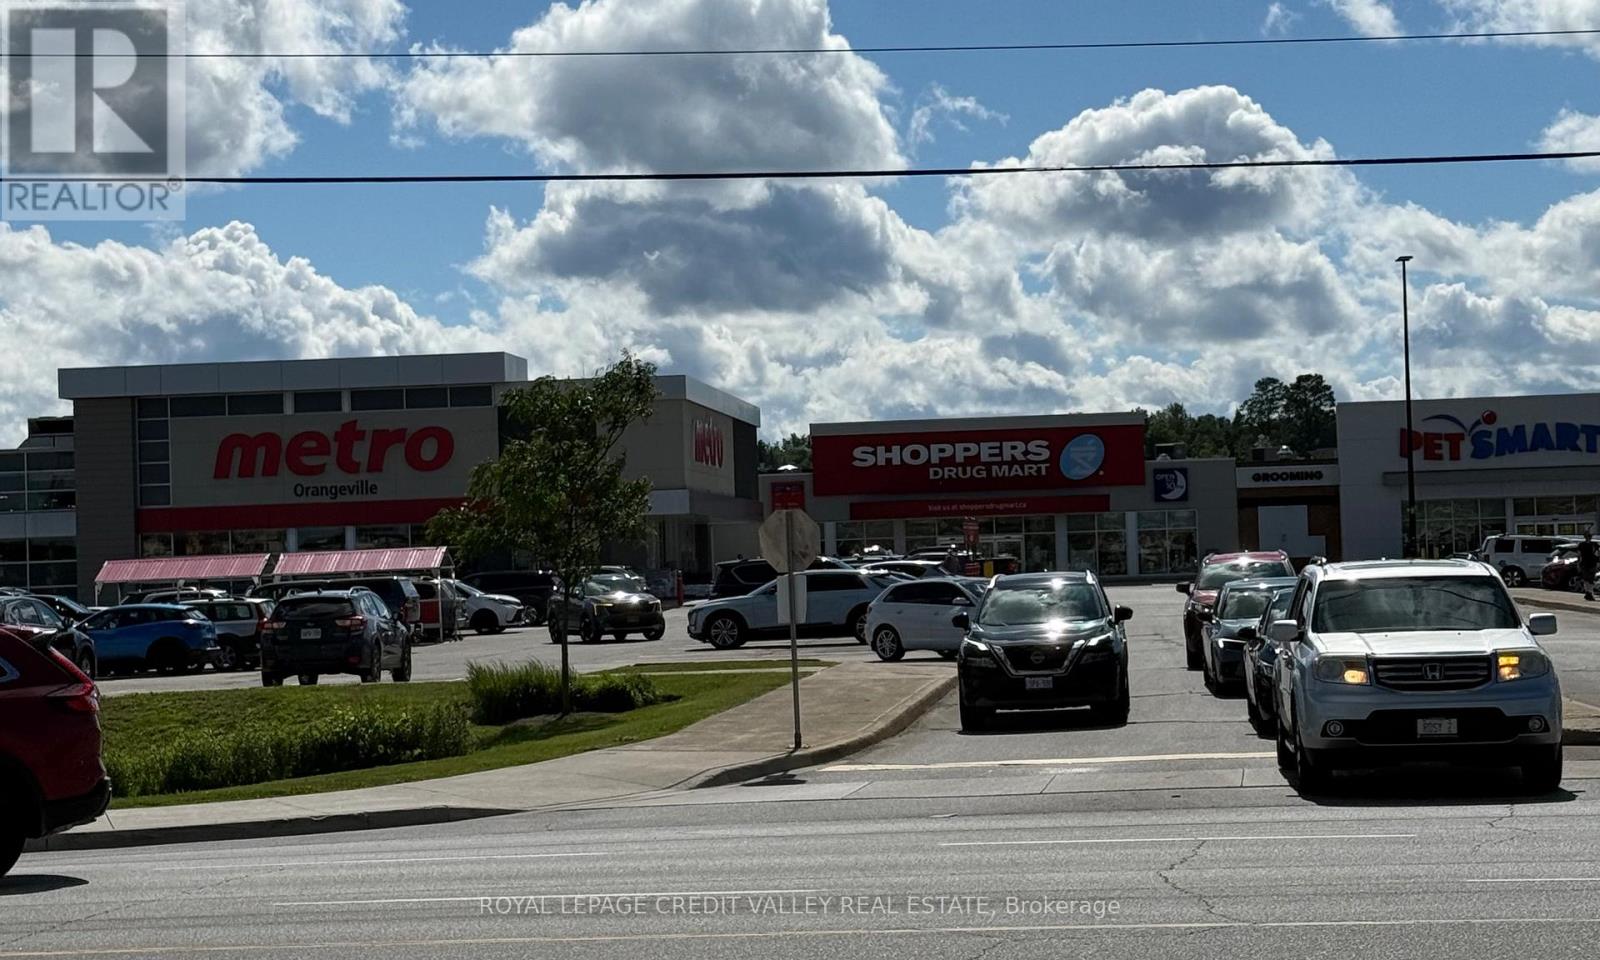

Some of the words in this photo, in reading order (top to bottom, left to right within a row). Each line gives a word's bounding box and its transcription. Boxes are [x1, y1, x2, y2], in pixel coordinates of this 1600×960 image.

[213, 419, 454, 480] metro
[695, 415, 723, 468] metro
[851, 440, 1050, 467] SHOPPERS
[929, 466, 987, 480] DRUG
[991, 463, 1050, 478] MART
[1252, 470, 1323, 482] GROOMING
[293, 480, 378, 499] Orangeville
